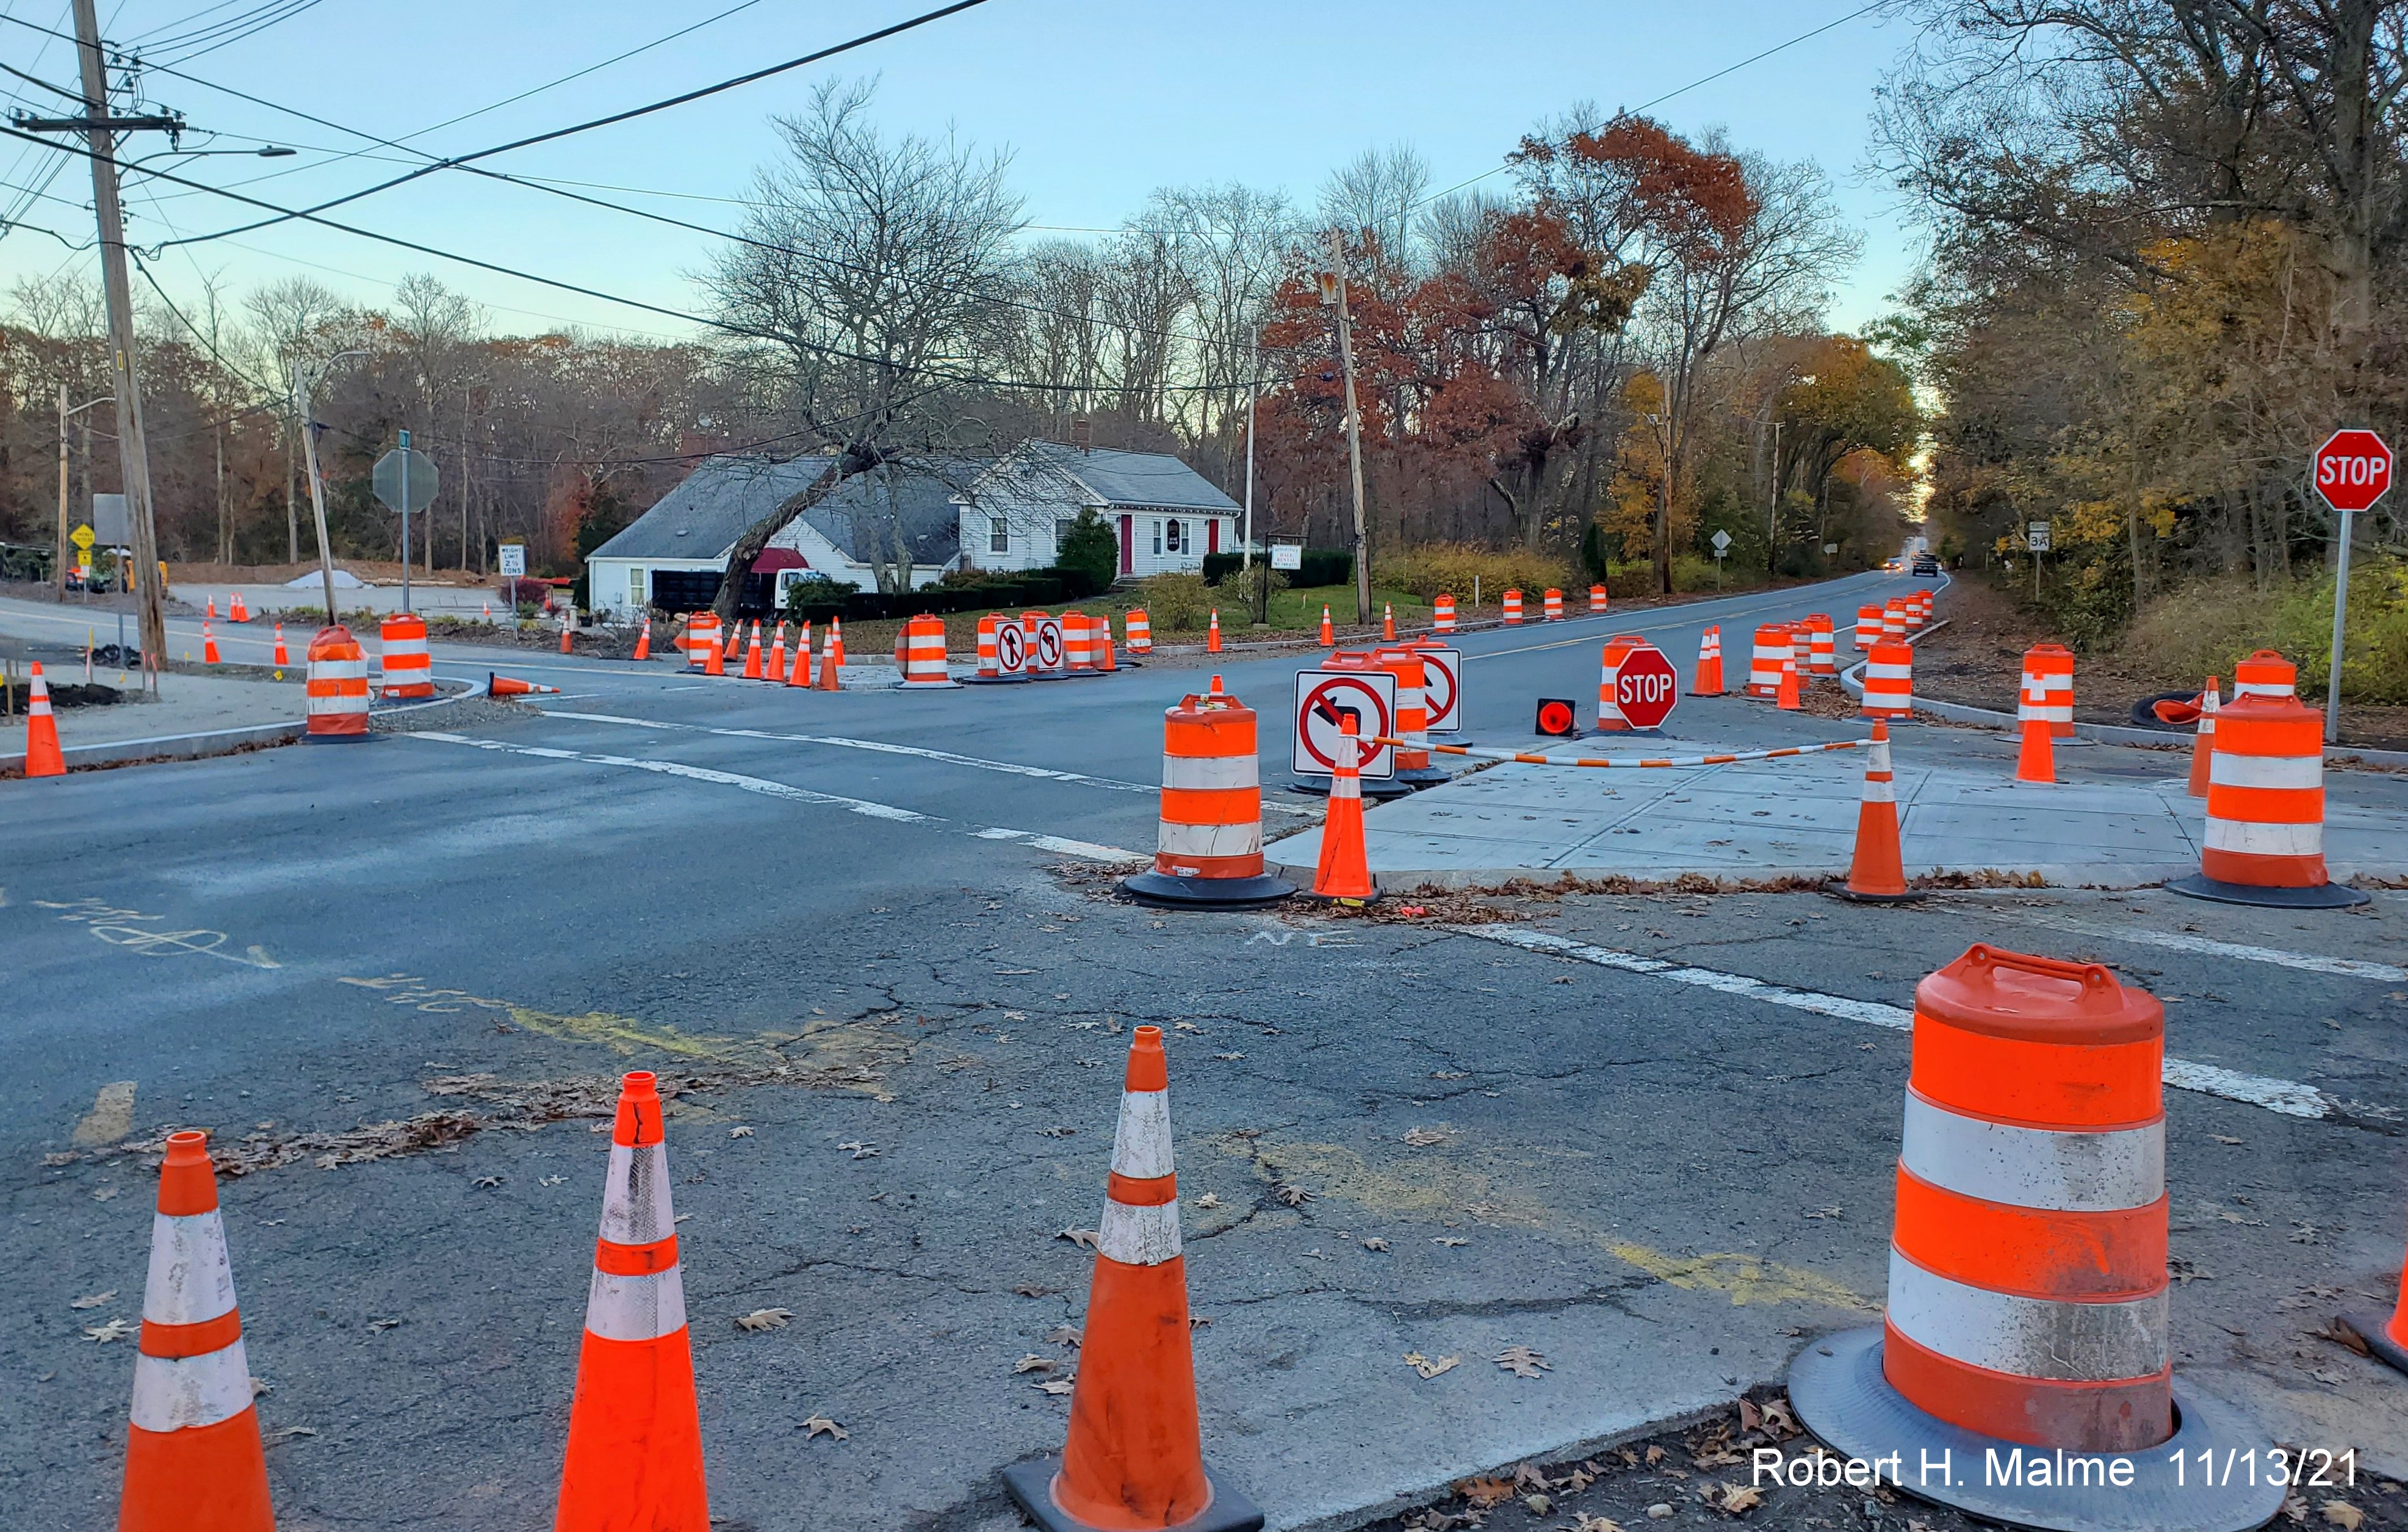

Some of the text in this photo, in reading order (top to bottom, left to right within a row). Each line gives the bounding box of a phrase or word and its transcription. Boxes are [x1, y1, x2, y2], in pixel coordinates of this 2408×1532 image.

[2320, 455, 2386, 485] STOP
[2031, 537, 2048, 546] 3A
[1620, 674, 1672, 704] STOP
